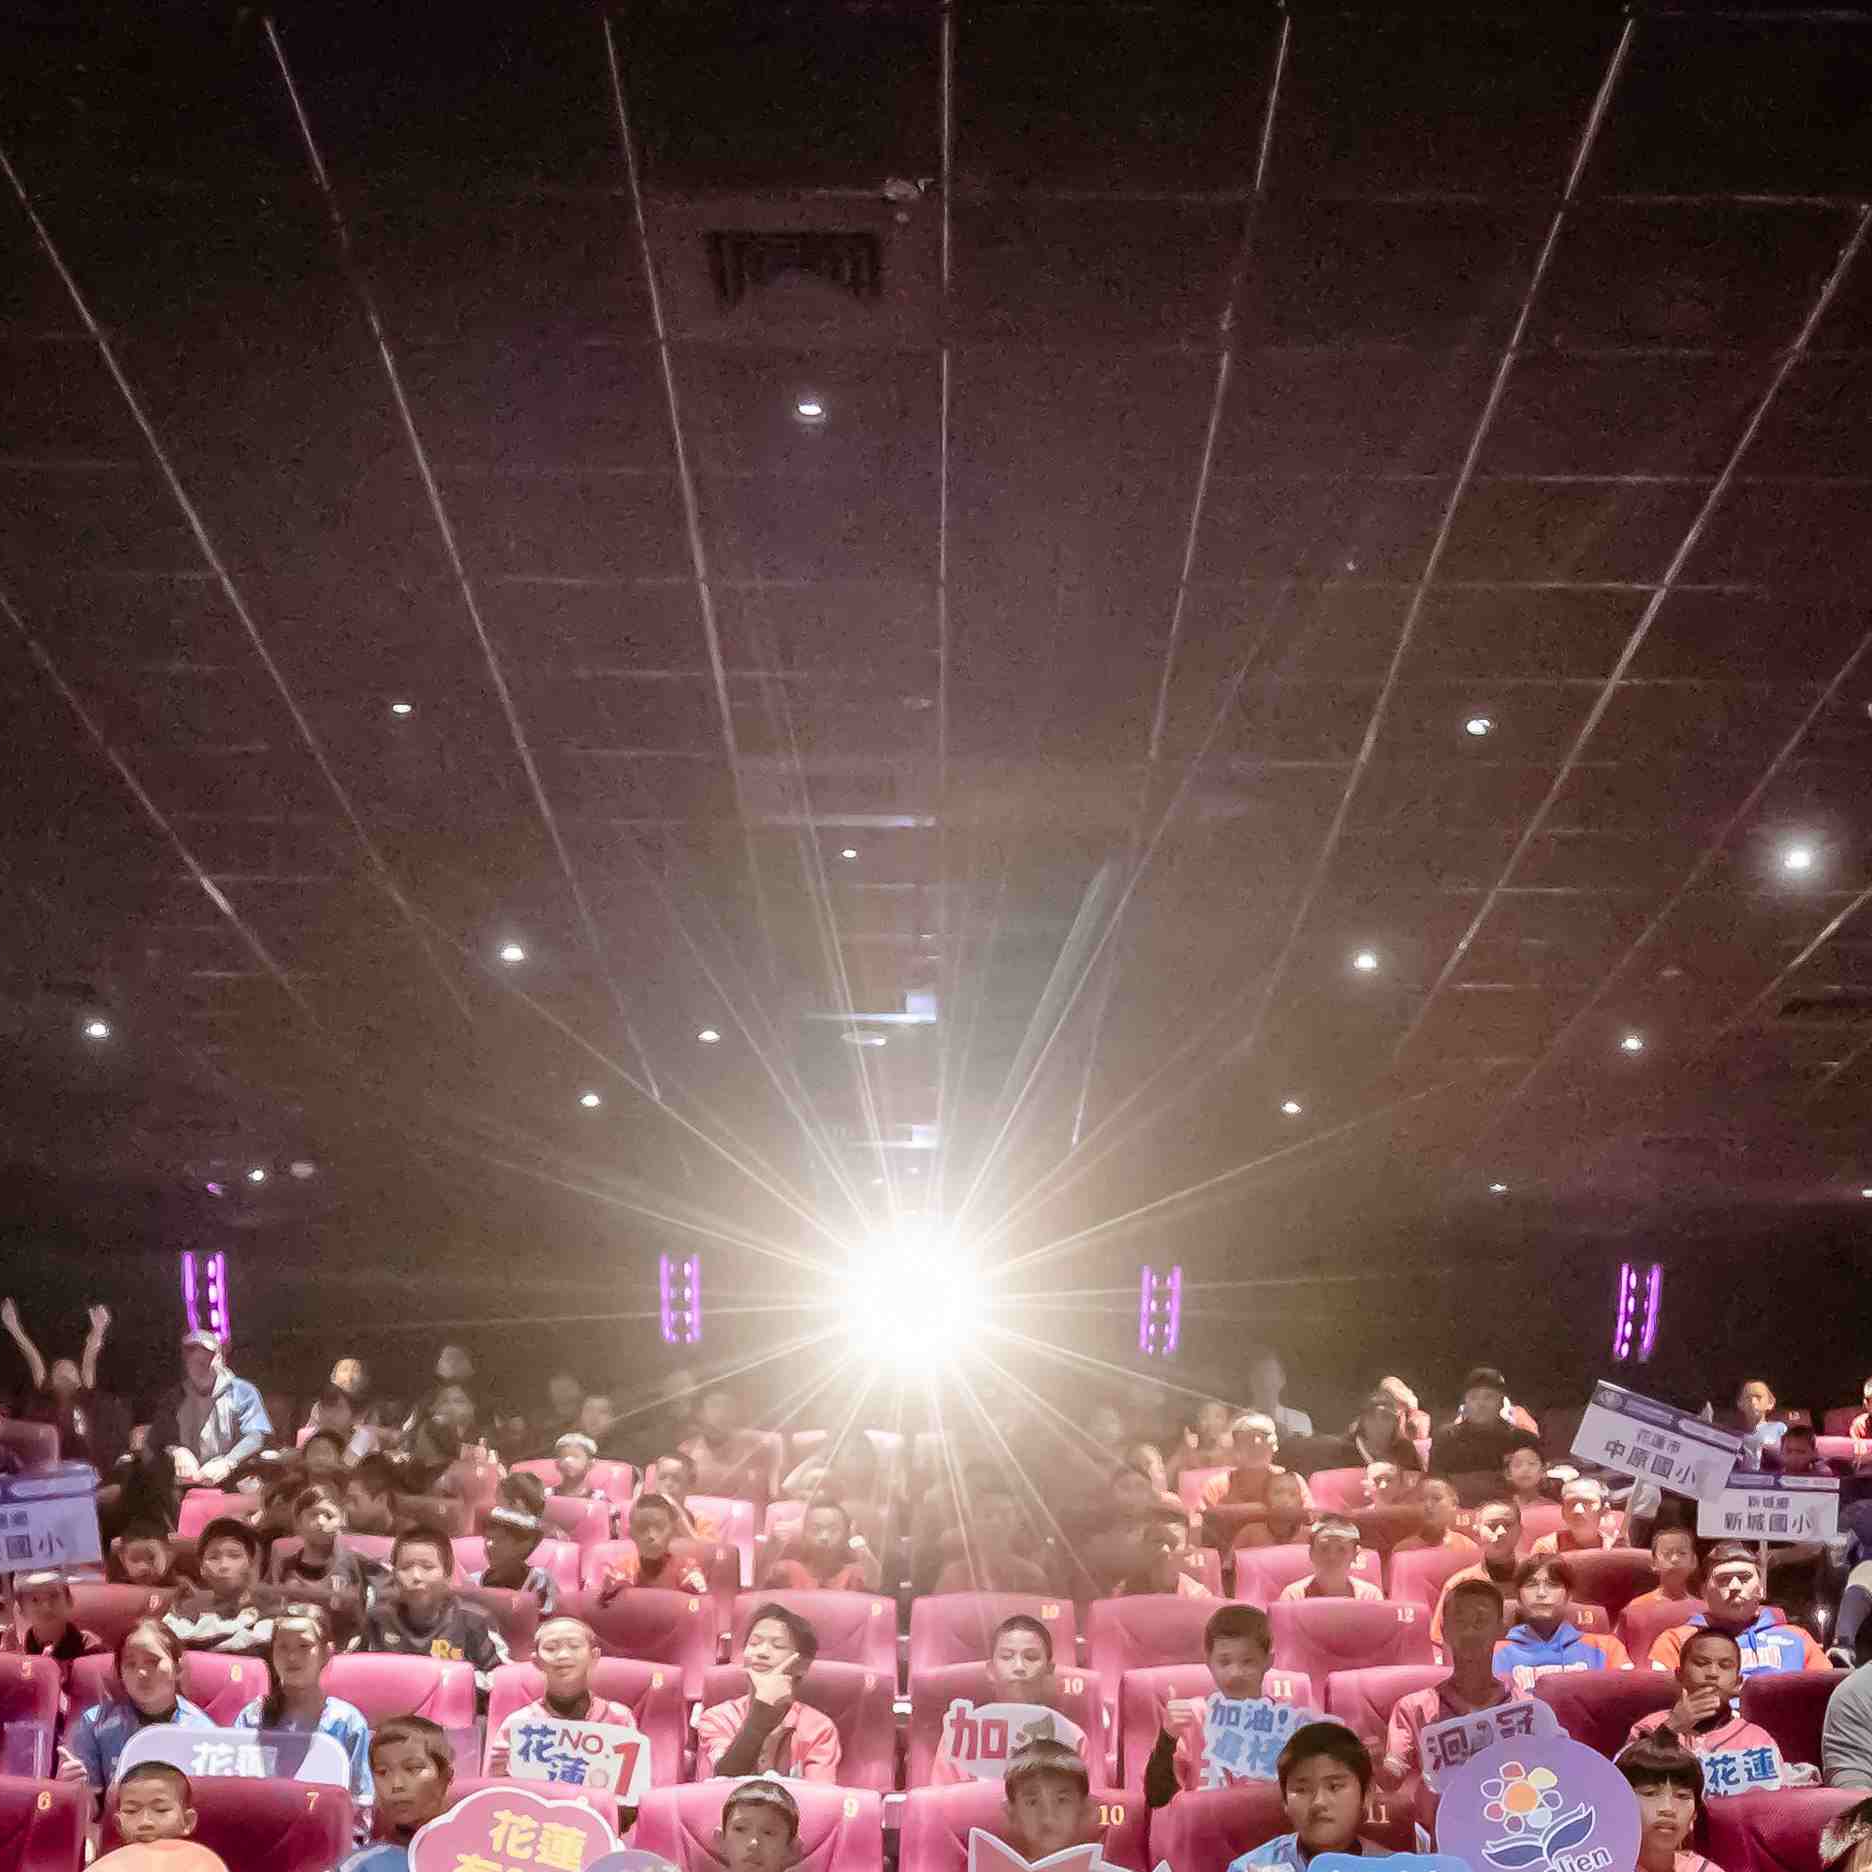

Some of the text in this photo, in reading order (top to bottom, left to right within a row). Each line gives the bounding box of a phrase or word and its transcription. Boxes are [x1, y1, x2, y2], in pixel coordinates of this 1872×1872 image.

[1396, 1607, 1415, 1624] 12
[1063, 1676, 1084, 1695] 10
[1271, 1679, 1293, 1698] 11
[1706, 1747, 1779, 1786] 花蓮
[36, 1791, 52, 1811] 6
[305, 1791, 321, 1812] 7
[842, 1796, 859, 1819] 9
[1099, 1804, 1126, 1826] 10
[1365, 1803, 1391, 1825] 11
[489, 1809, 588, 1872] 花蓮
